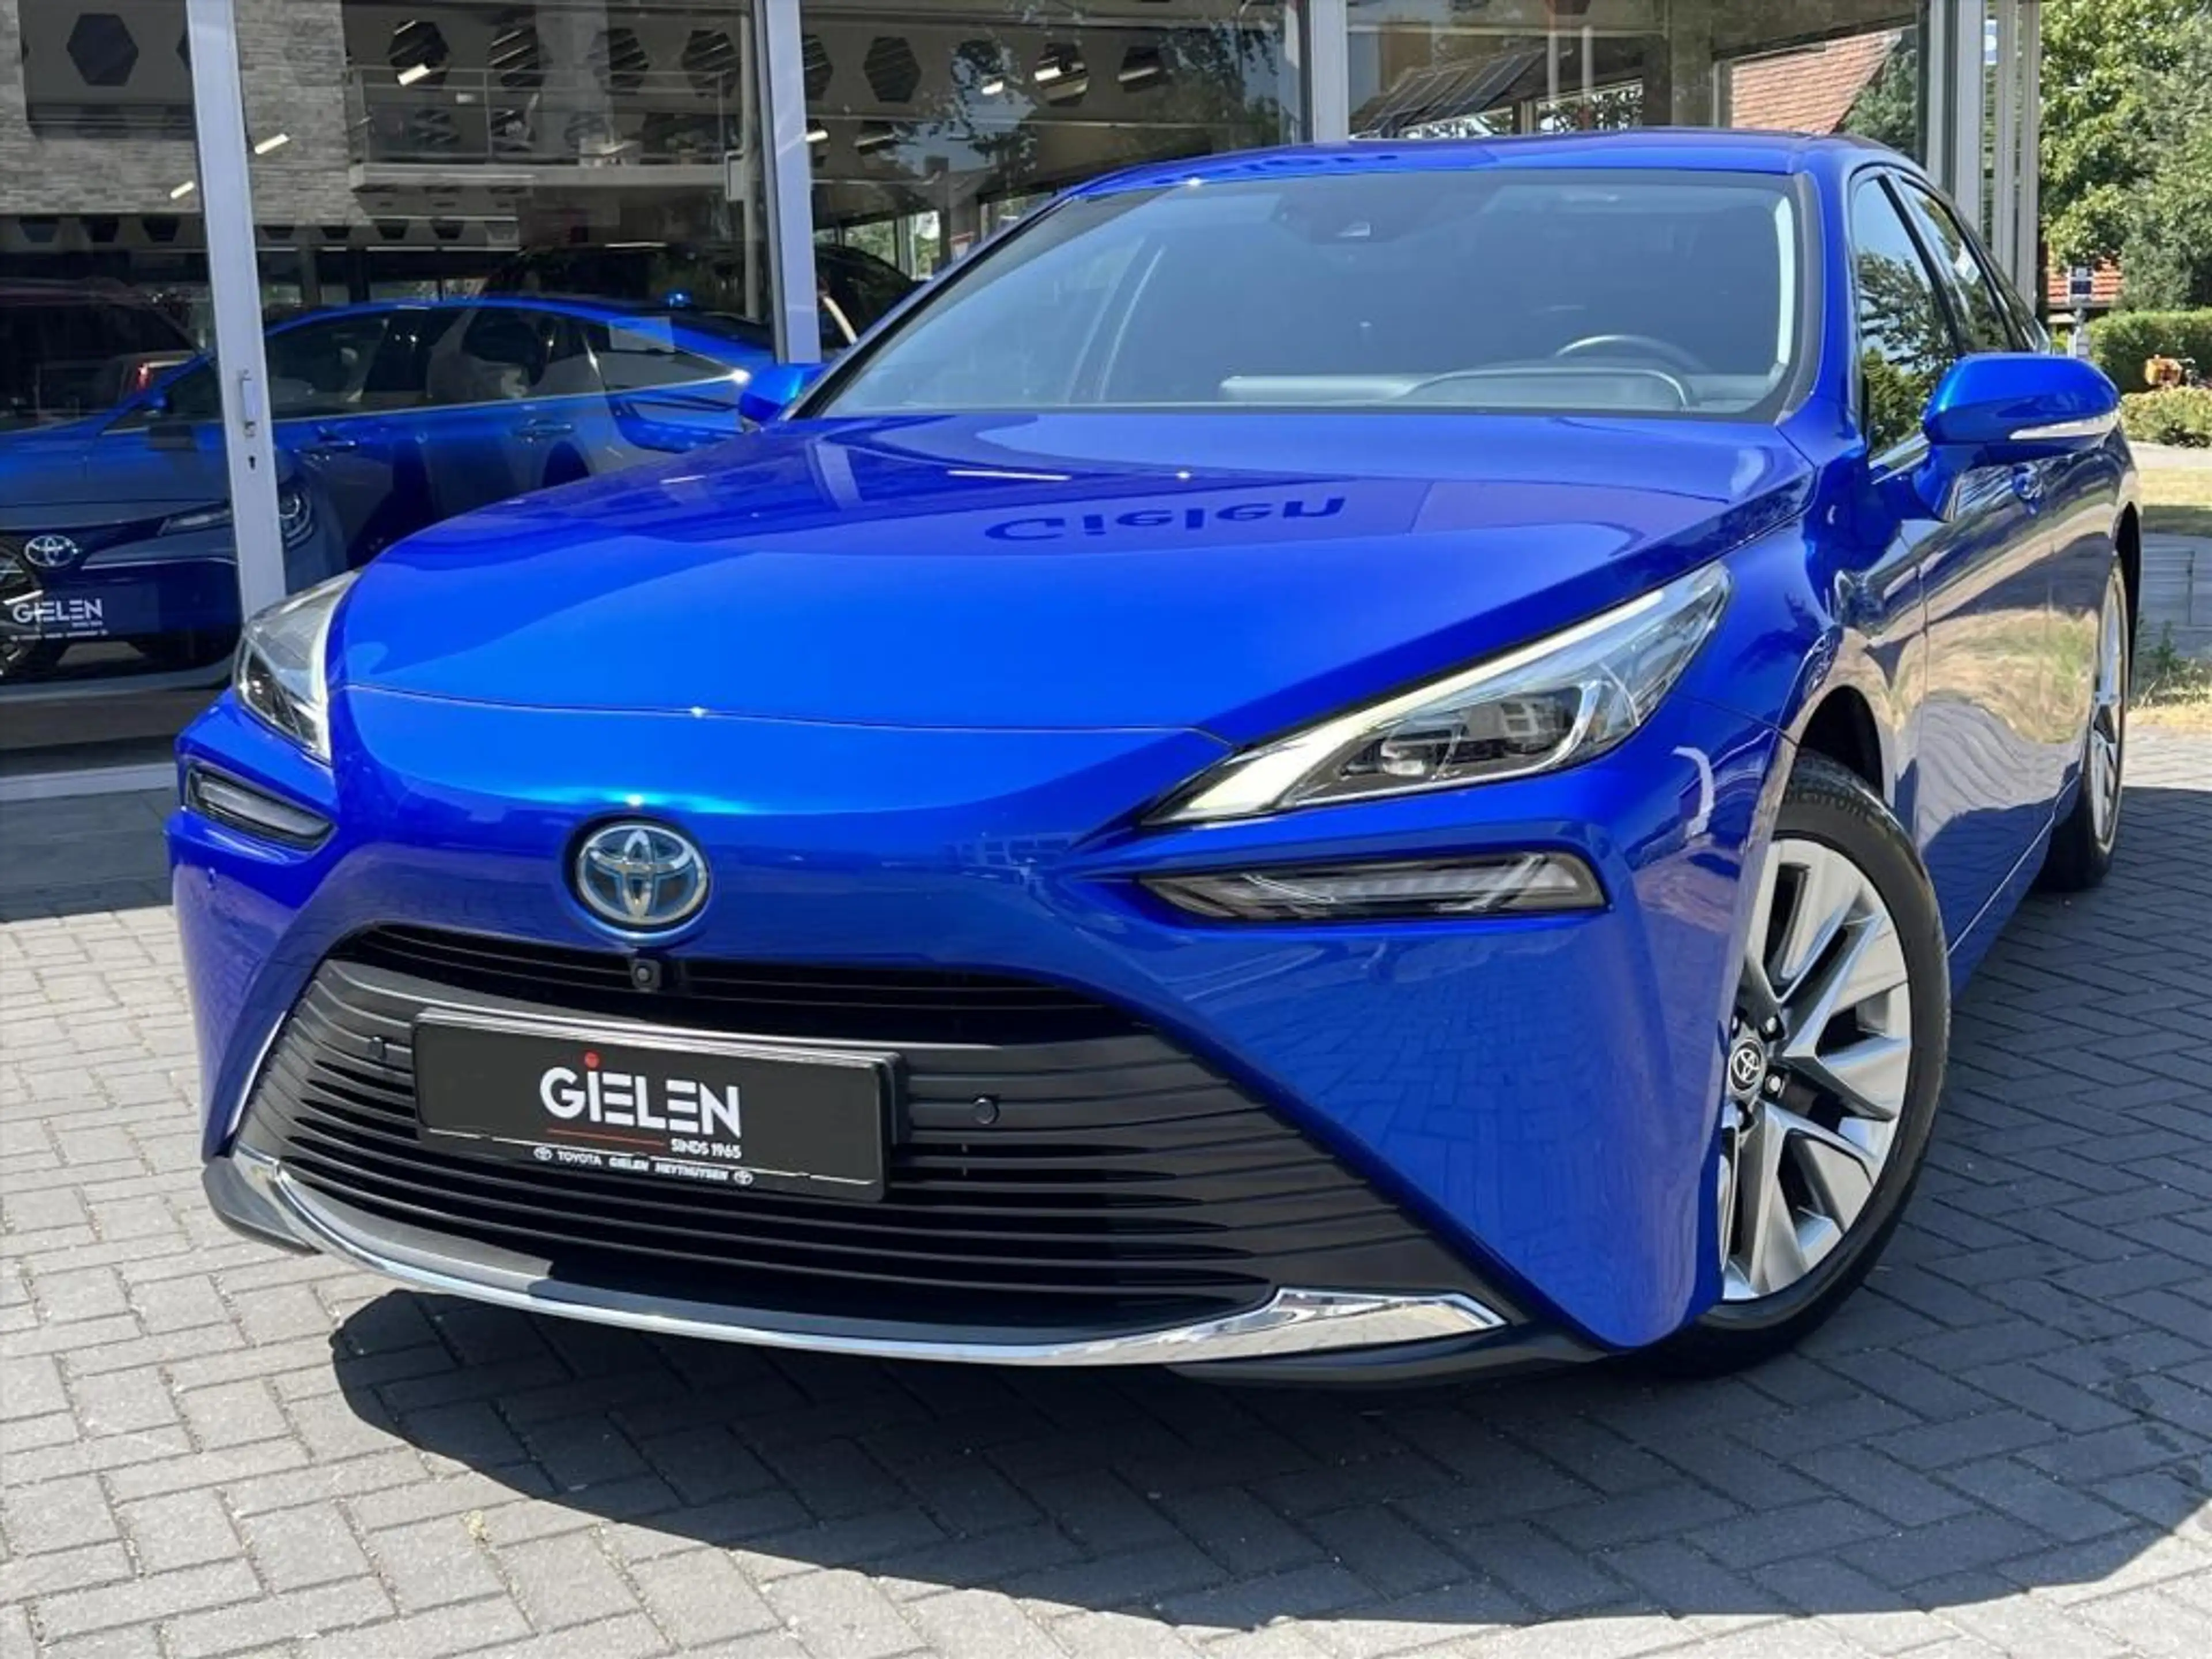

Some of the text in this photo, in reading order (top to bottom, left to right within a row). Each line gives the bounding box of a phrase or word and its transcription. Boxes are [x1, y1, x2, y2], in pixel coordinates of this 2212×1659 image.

[539, 1050, 742, 1138] GIELEN
[671, 1138, 742, 1159] SINDS 1965
[557, 1150, 602, 1166] TOYOTA
[609, 1156, 649, 1172] GIELEN
